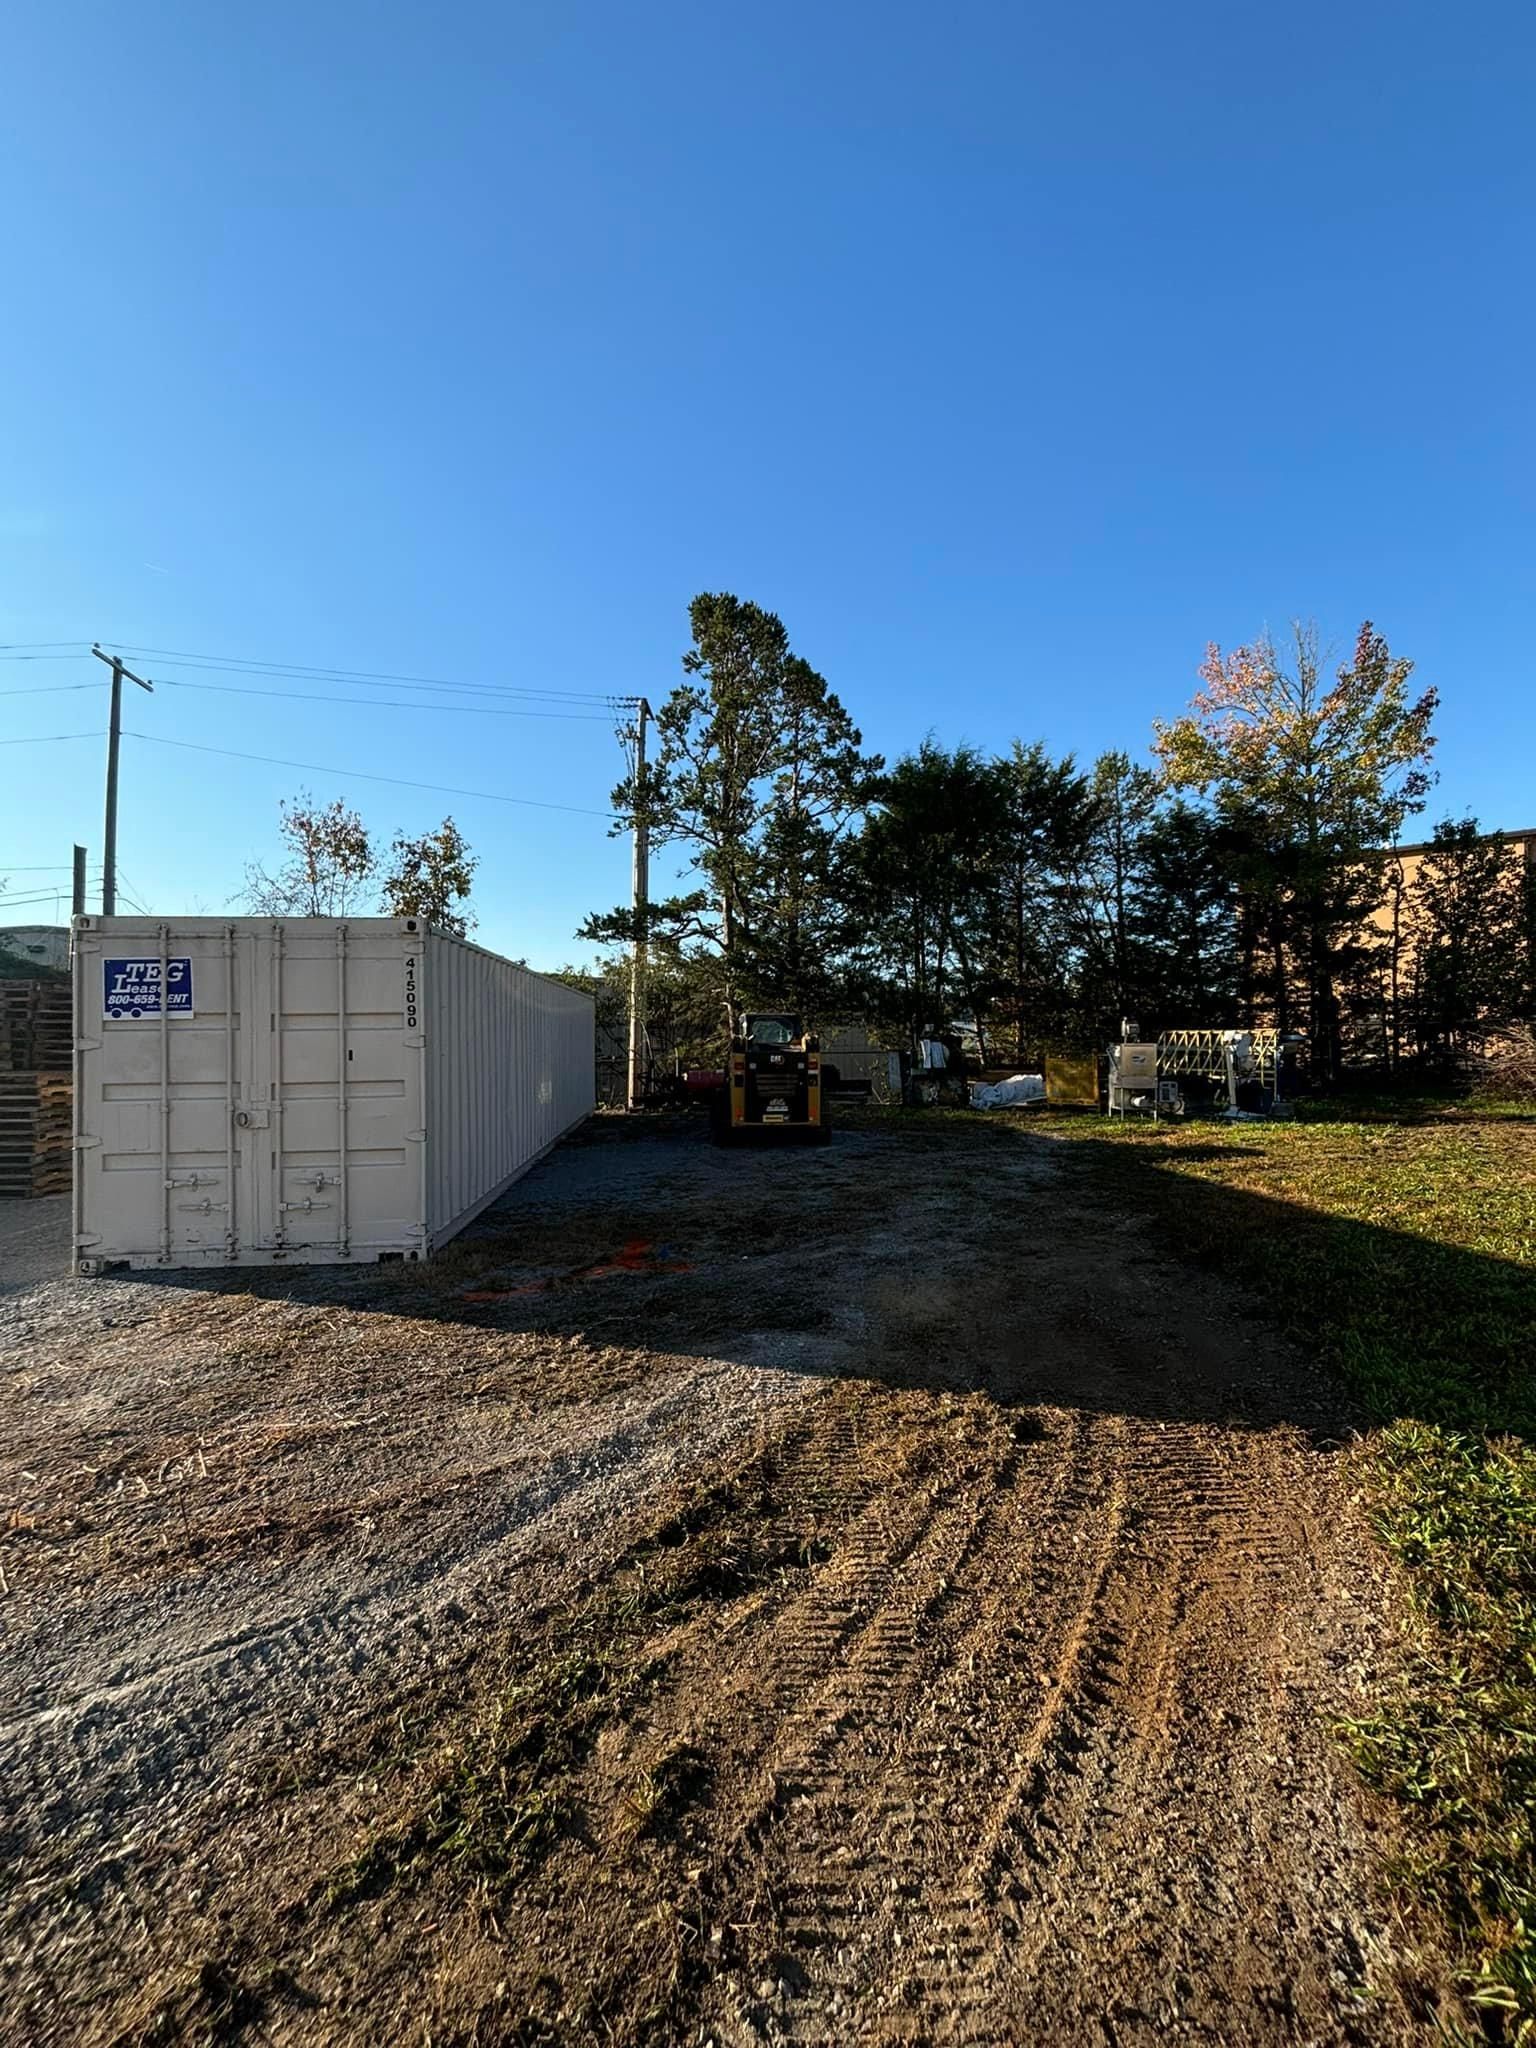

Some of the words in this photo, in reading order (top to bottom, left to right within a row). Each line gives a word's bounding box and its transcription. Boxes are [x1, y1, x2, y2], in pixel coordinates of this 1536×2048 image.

[126, 962, 184, 982] TEG
[107, 994, 189, 1005] 800-659-ENT
[406, 958, 416, 1027] 415090
